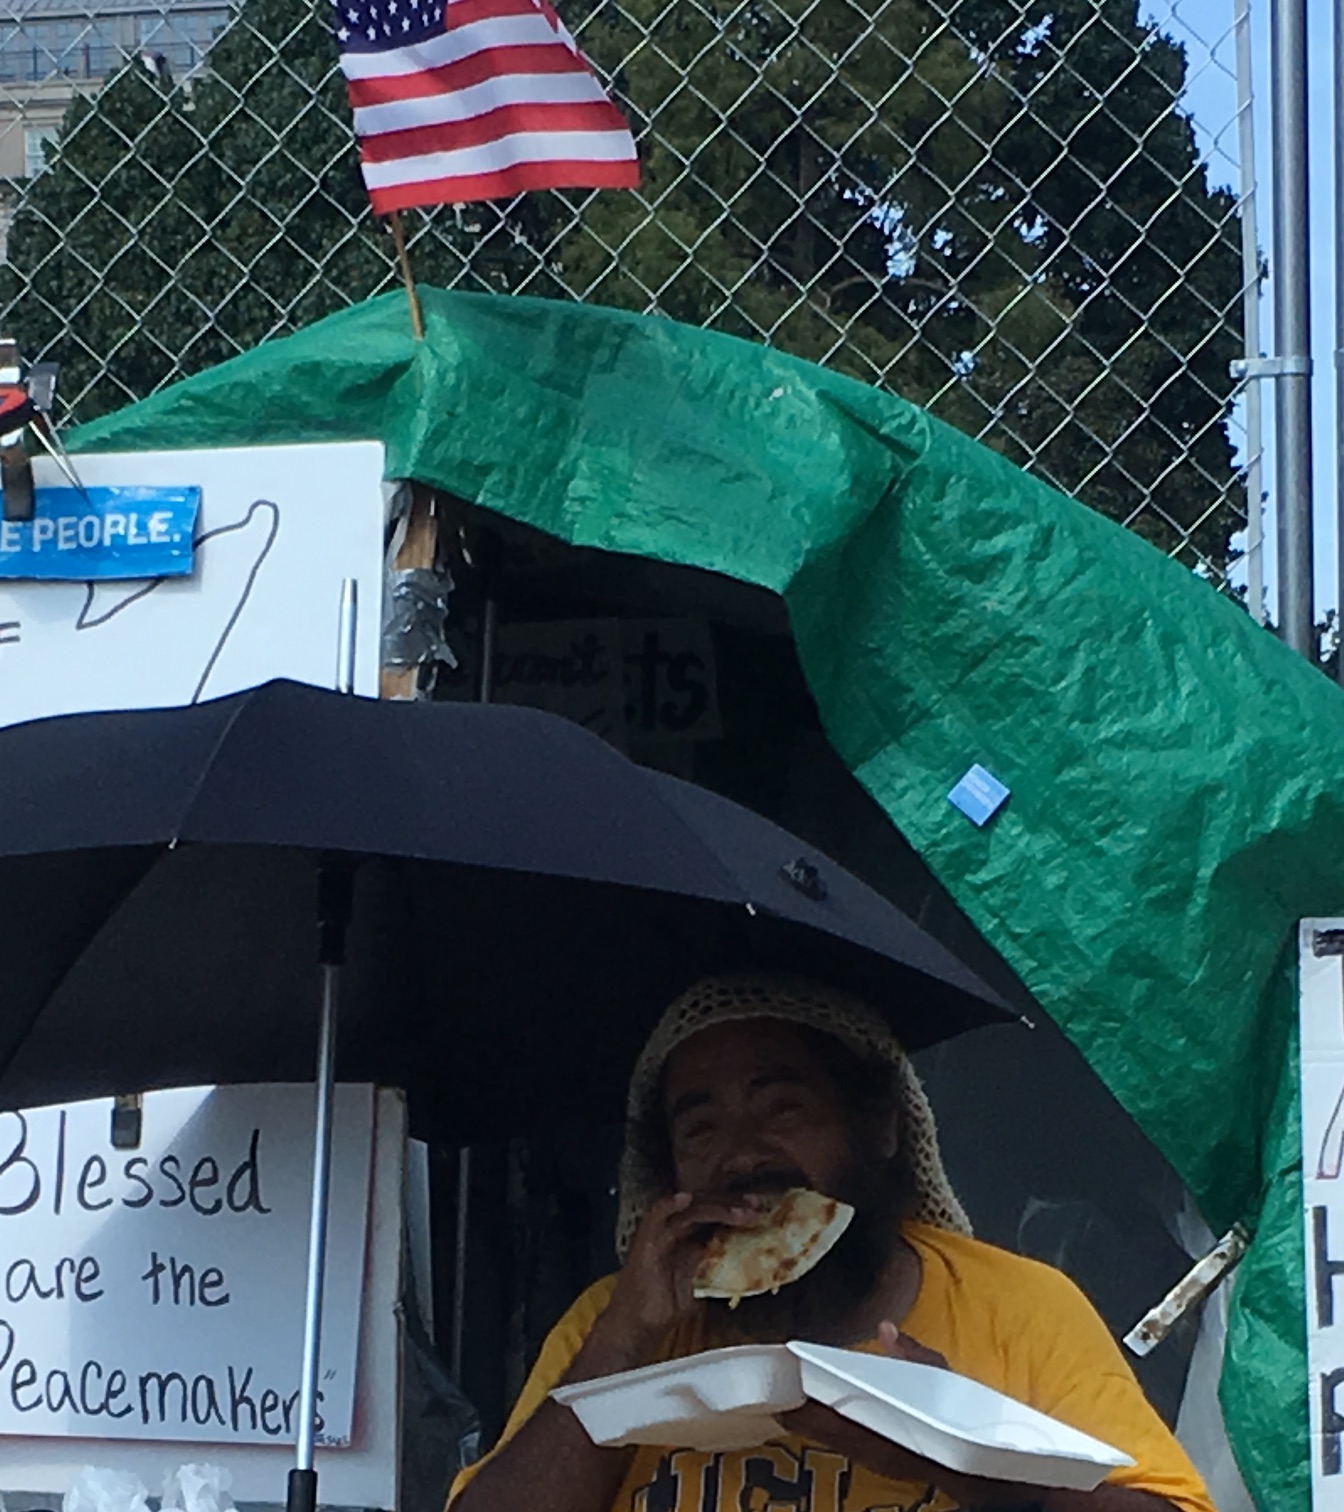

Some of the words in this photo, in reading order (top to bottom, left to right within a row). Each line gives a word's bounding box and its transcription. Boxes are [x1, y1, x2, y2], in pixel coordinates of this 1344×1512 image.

[32, 511, 182, 552] PEOPLE.
[6, 1256, 105, 1304] are
[141, 1251, 231, 1308] the
